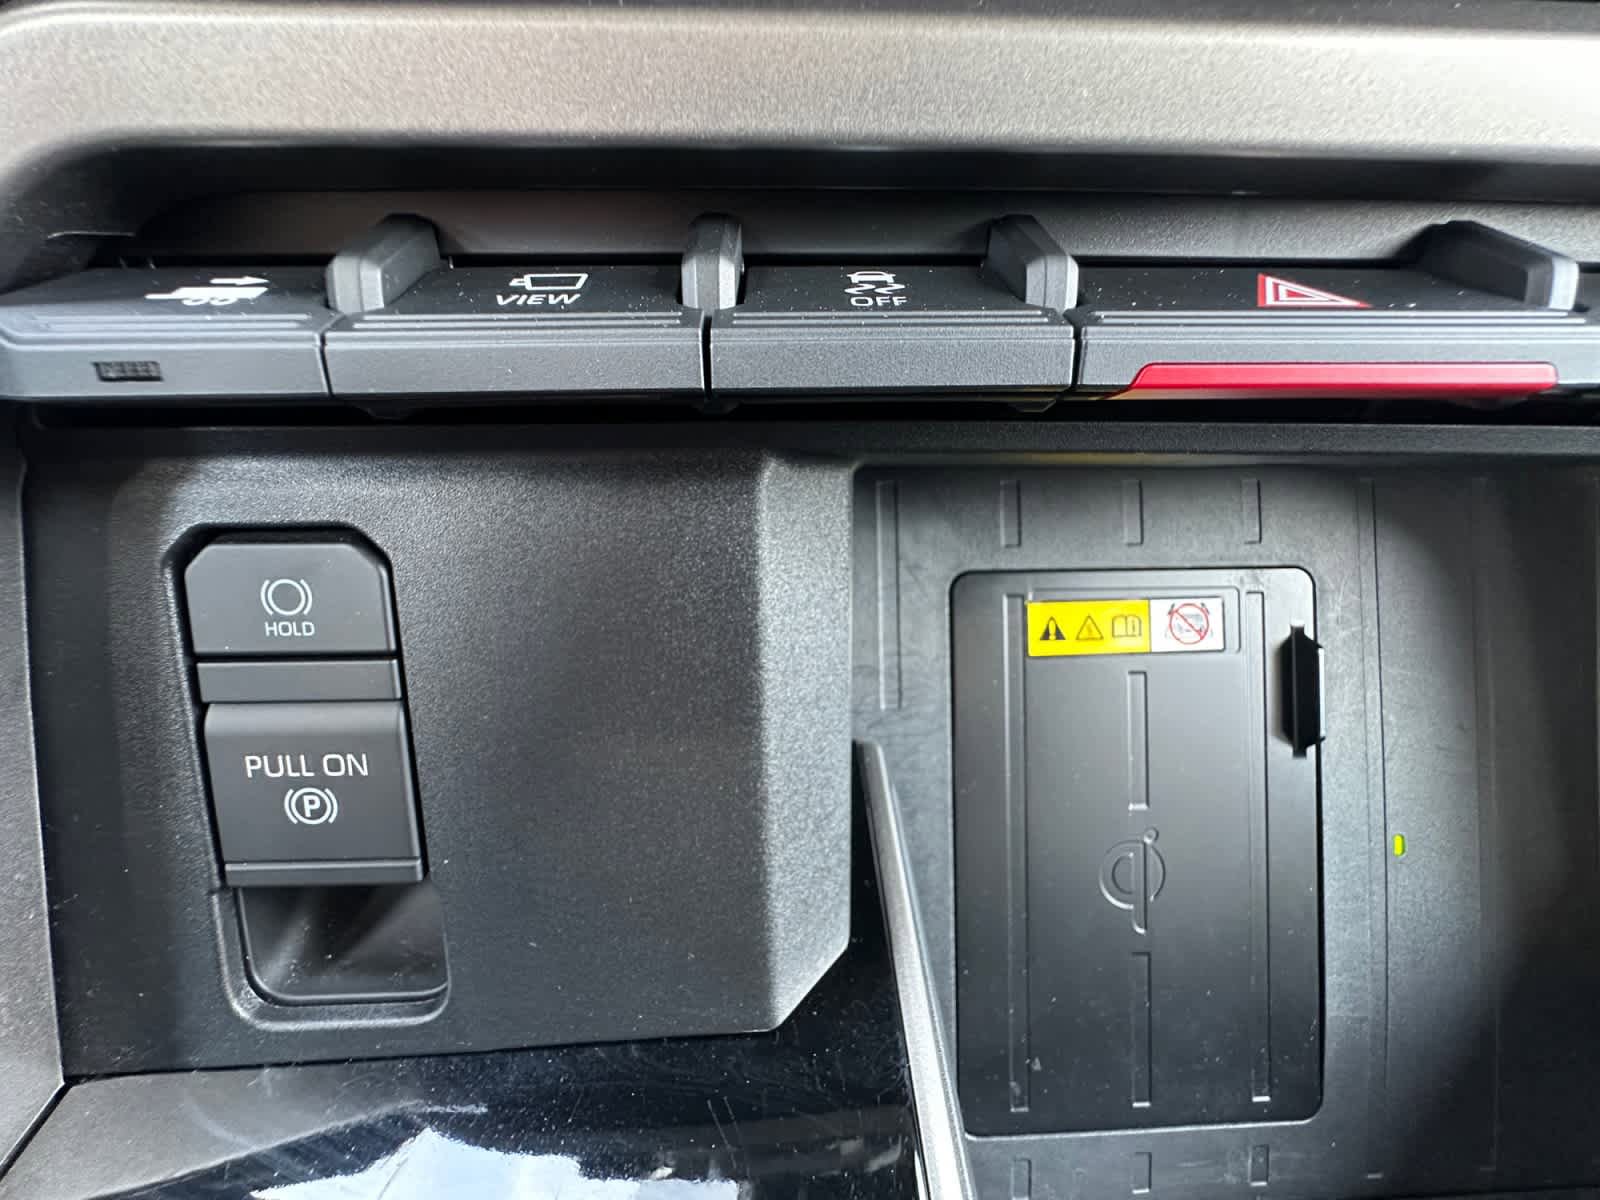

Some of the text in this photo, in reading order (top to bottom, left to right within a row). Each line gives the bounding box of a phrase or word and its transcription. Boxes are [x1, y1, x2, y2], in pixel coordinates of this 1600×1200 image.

[496, 293, 581, 306] VIEW
[850, 296, 907, 307] OFF
[264, 621, 315, 637] HOLD
[244, 753, 369, 778] PULL ON
[302, 794, 321, 818] P
